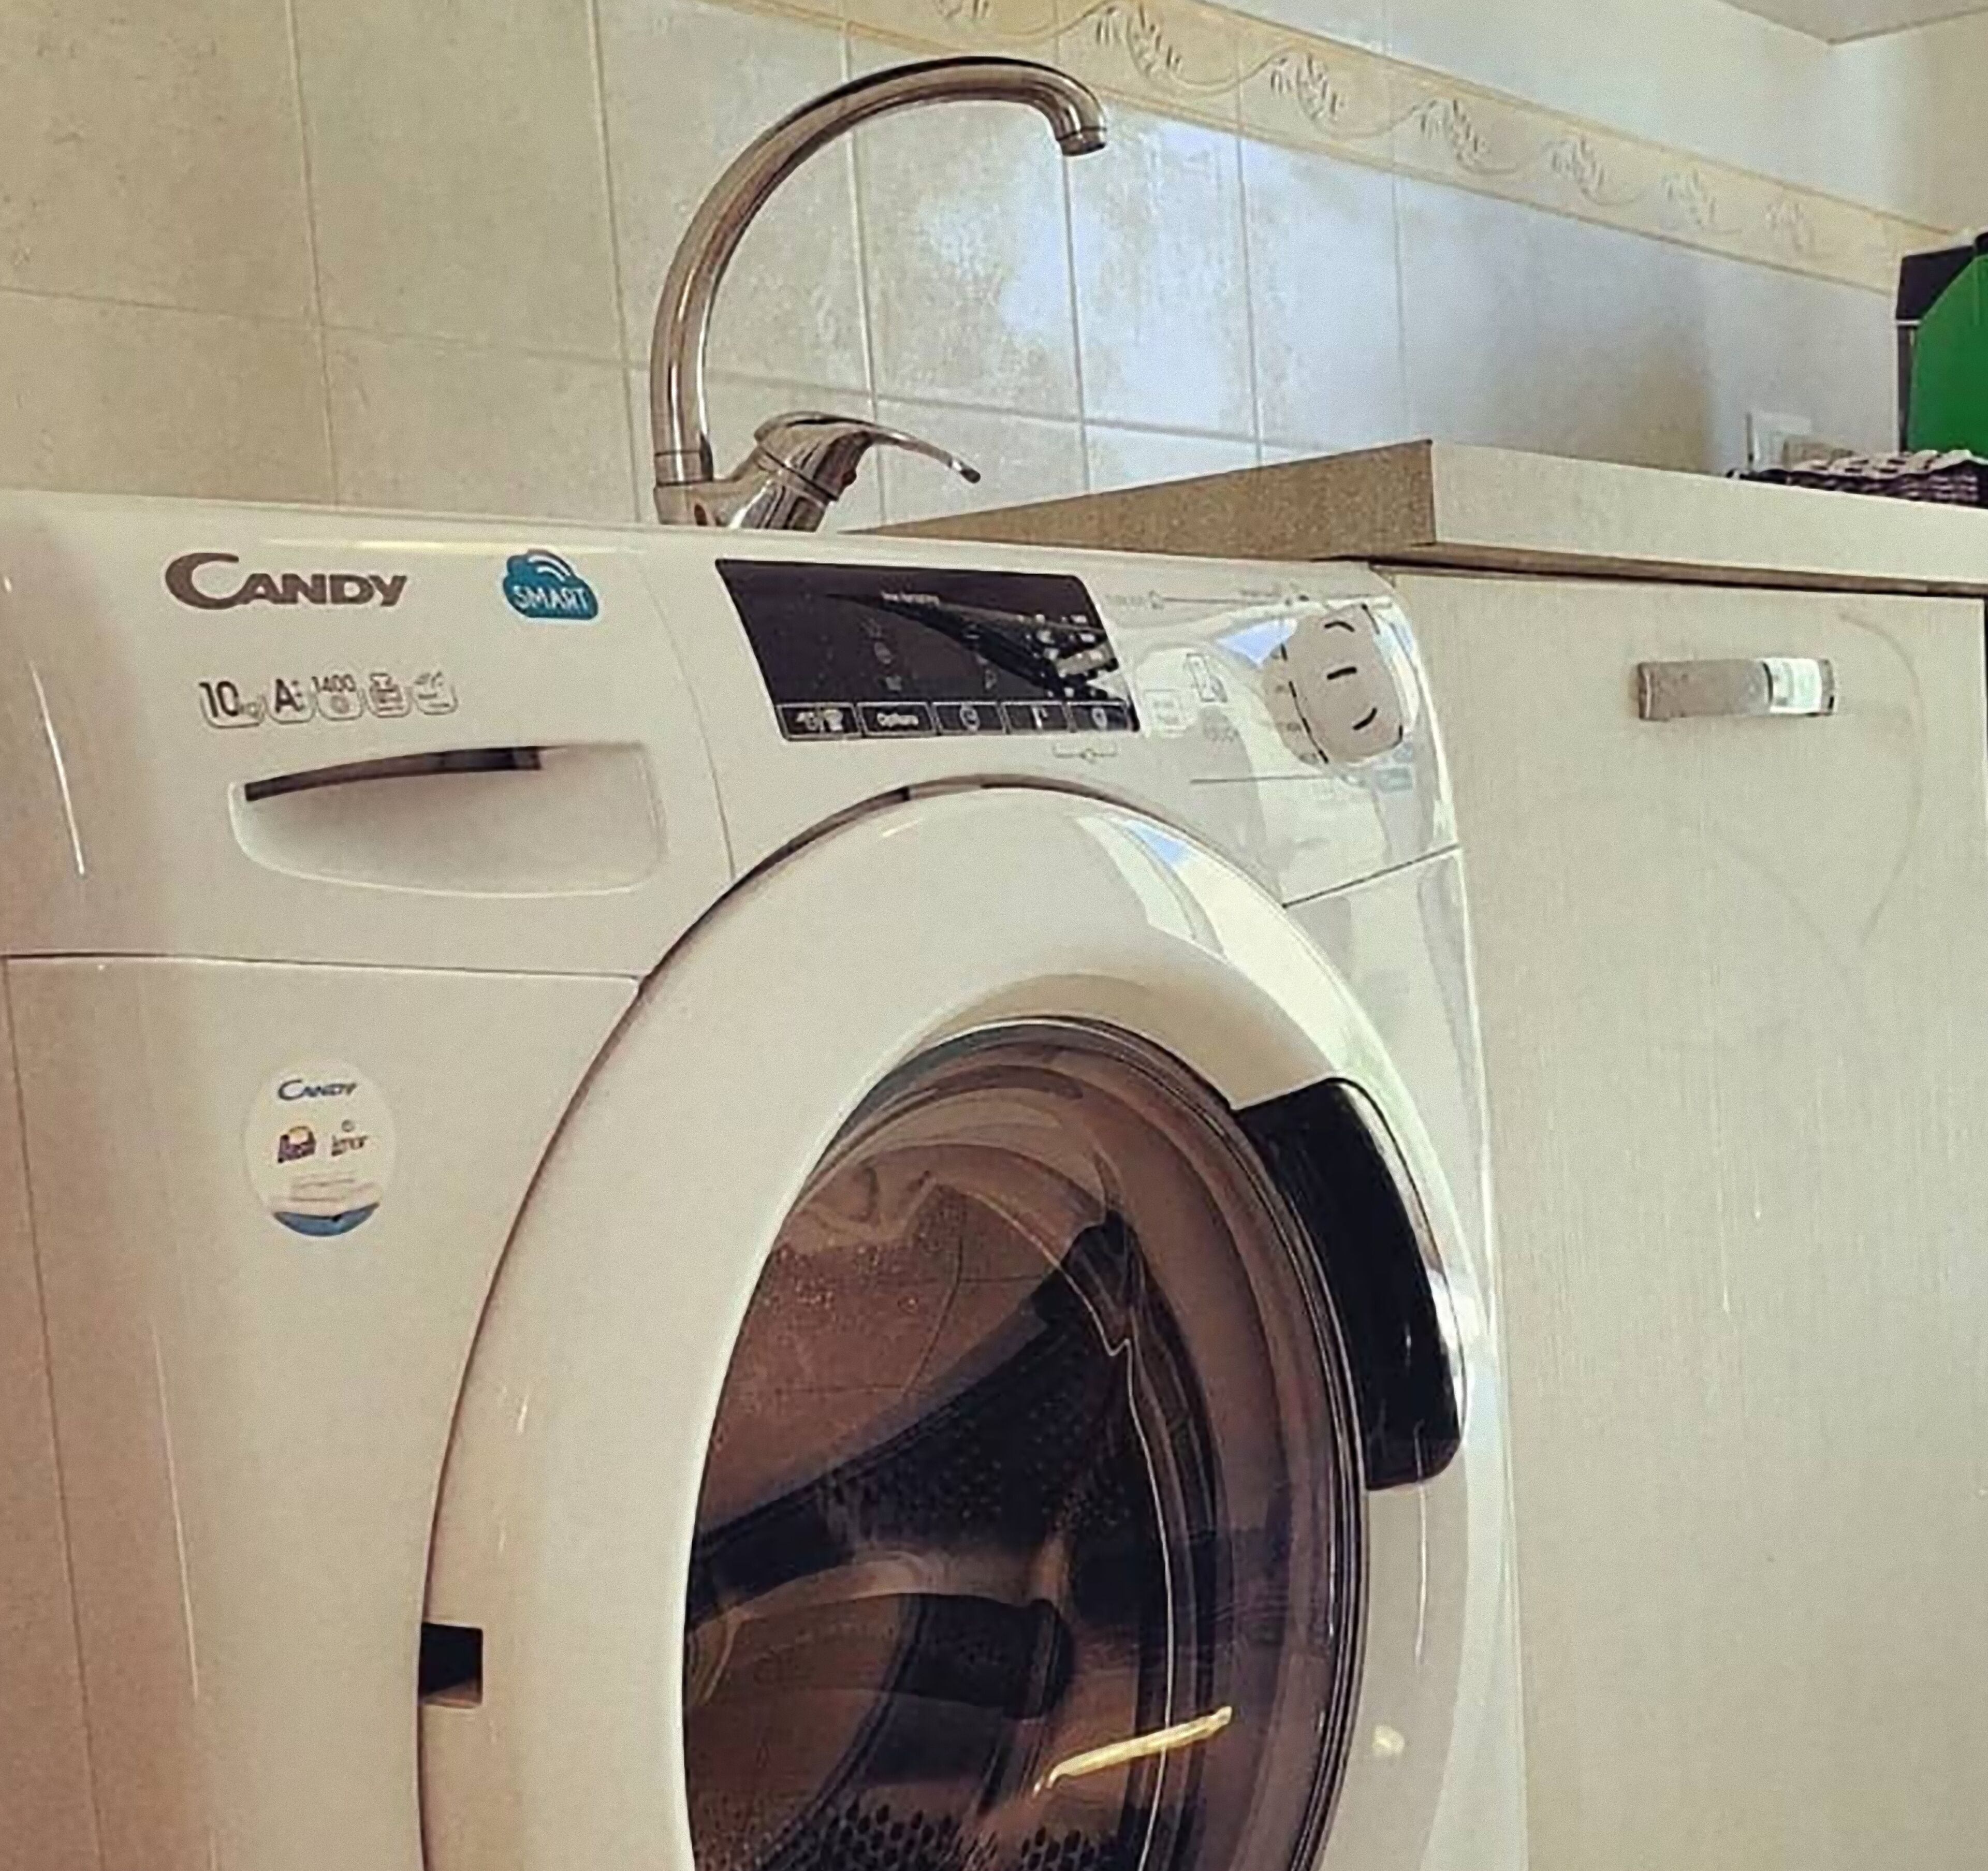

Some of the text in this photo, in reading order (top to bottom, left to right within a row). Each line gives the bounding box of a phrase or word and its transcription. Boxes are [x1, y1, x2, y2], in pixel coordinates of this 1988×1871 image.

[165, 552, 407, 610] CANDY
[513, 586, 589, 609] SMART
[199, 680, 239, 717] 10
[312, 674, 357, 693] 1400
